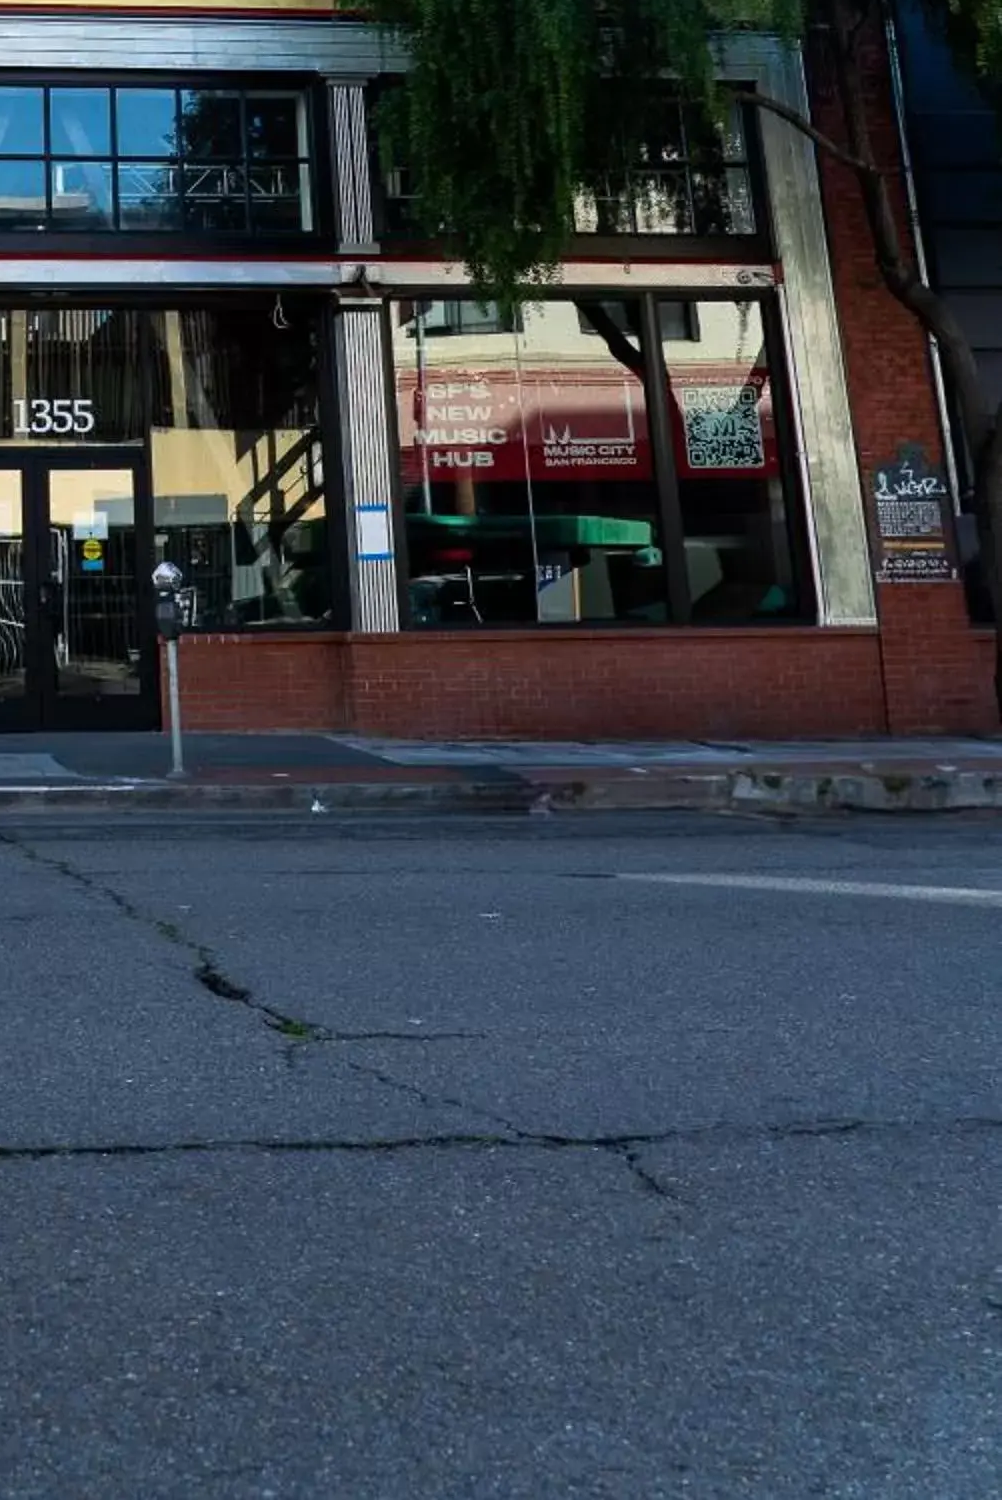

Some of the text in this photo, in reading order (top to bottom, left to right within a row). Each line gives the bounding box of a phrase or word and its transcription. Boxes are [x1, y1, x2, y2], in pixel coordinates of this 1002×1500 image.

[13, 399, 95, 434] 1355
[427, 405, 493, 421] NEW
[413, 428, 508, 445] MUSIC
[543, 445, 636, 457] MUSIC CITY
[432, 451, 496, 468] HUB
[545, 458, 570, 467] SAN
